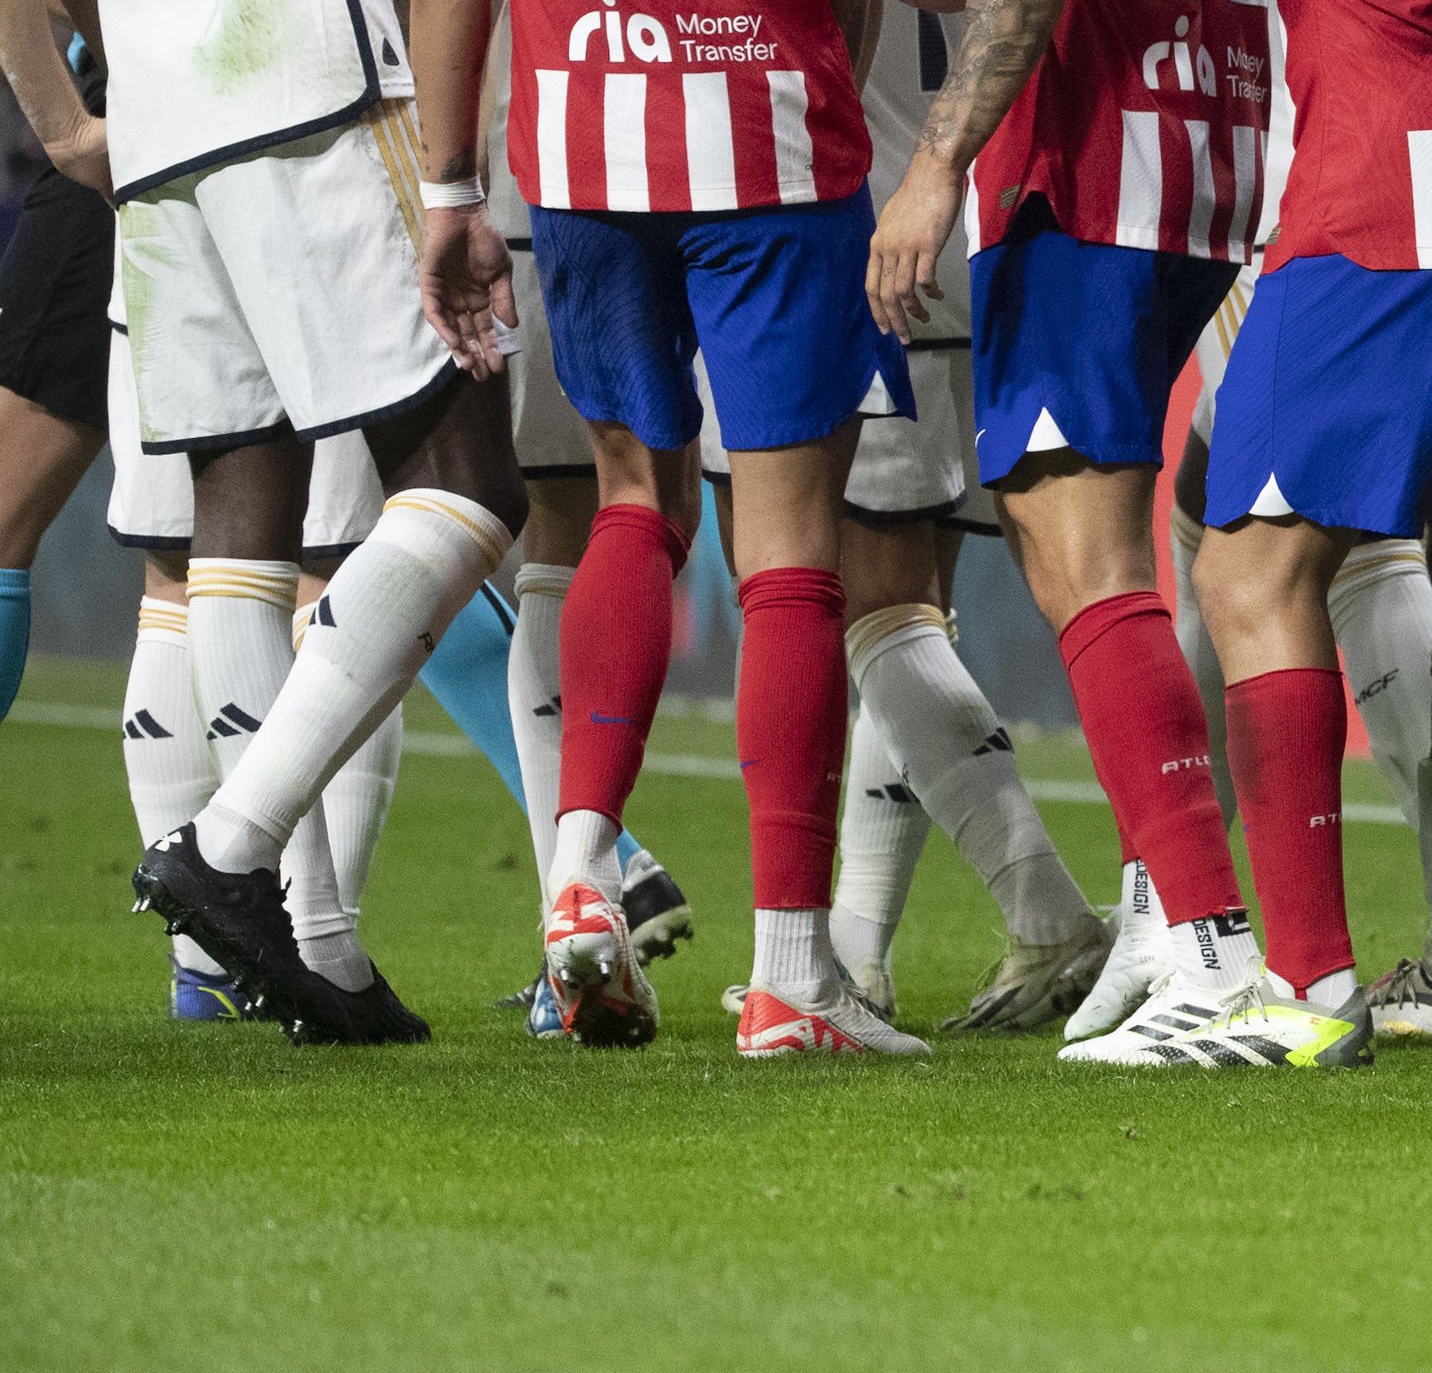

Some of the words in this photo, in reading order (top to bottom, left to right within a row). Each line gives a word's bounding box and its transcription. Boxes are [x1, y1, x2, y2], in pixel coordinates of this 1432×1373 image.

[676, 13, 763, 38] Money
[679, 38, 778, 64] Transfer
[1142, 14, 1217, 98] ria
